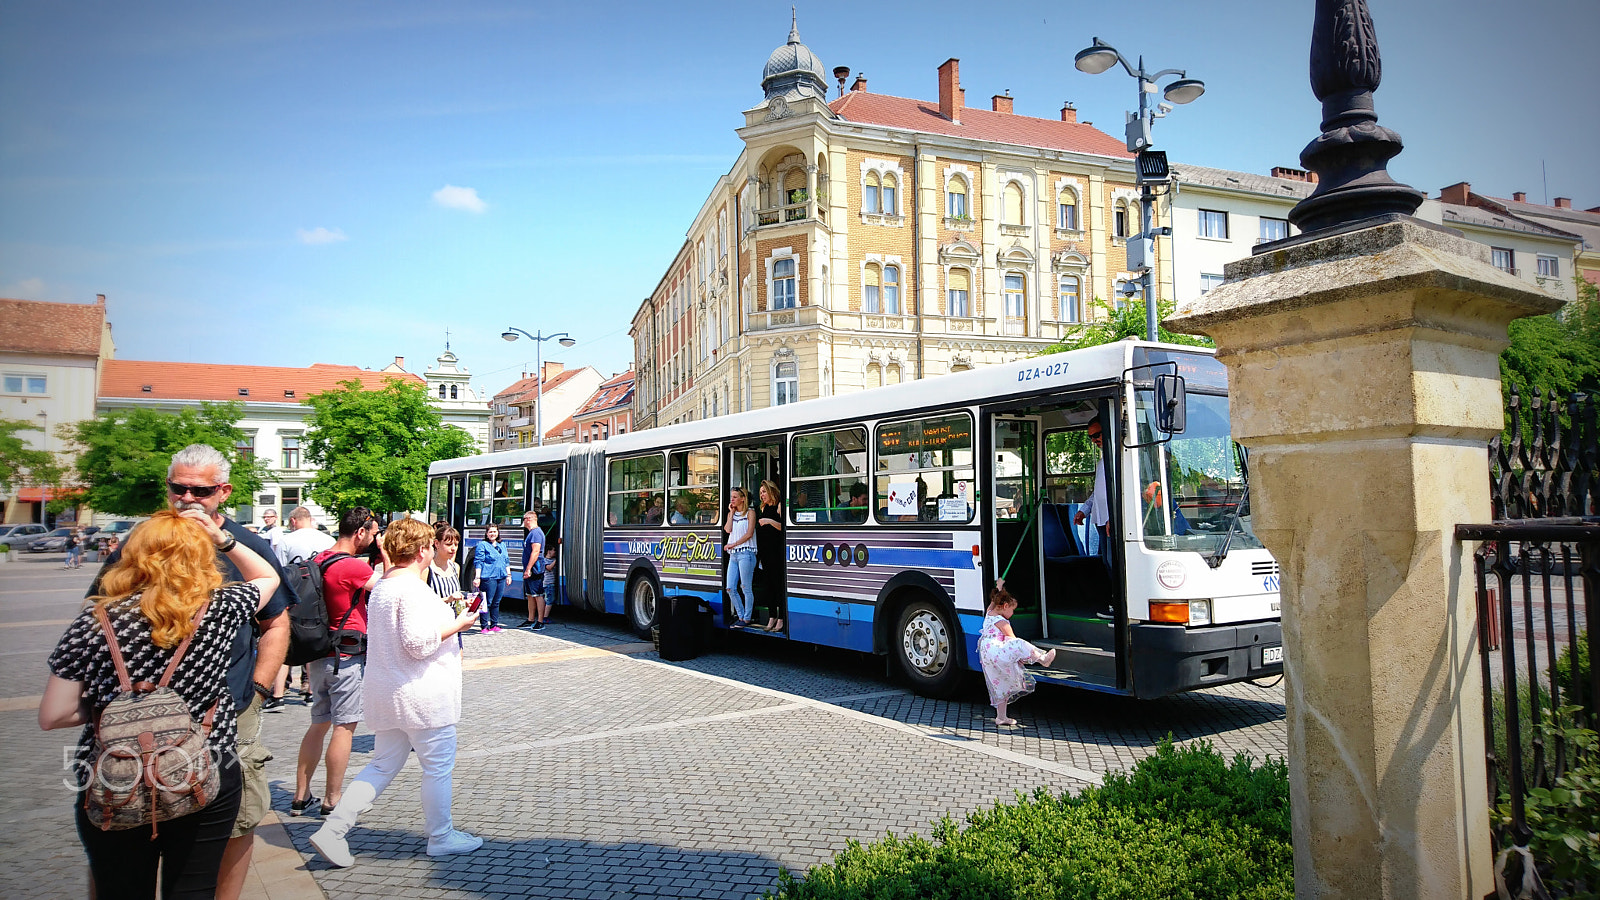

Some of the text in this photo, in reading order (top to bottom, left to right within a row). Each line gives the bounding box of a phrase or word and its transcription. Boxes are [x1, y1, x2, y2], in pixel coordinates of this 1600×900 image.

[1018, 363, 1069, 381] DZA-027
[628, 532, 819, 567] VÁROSI Kult-Tour BUSZ
